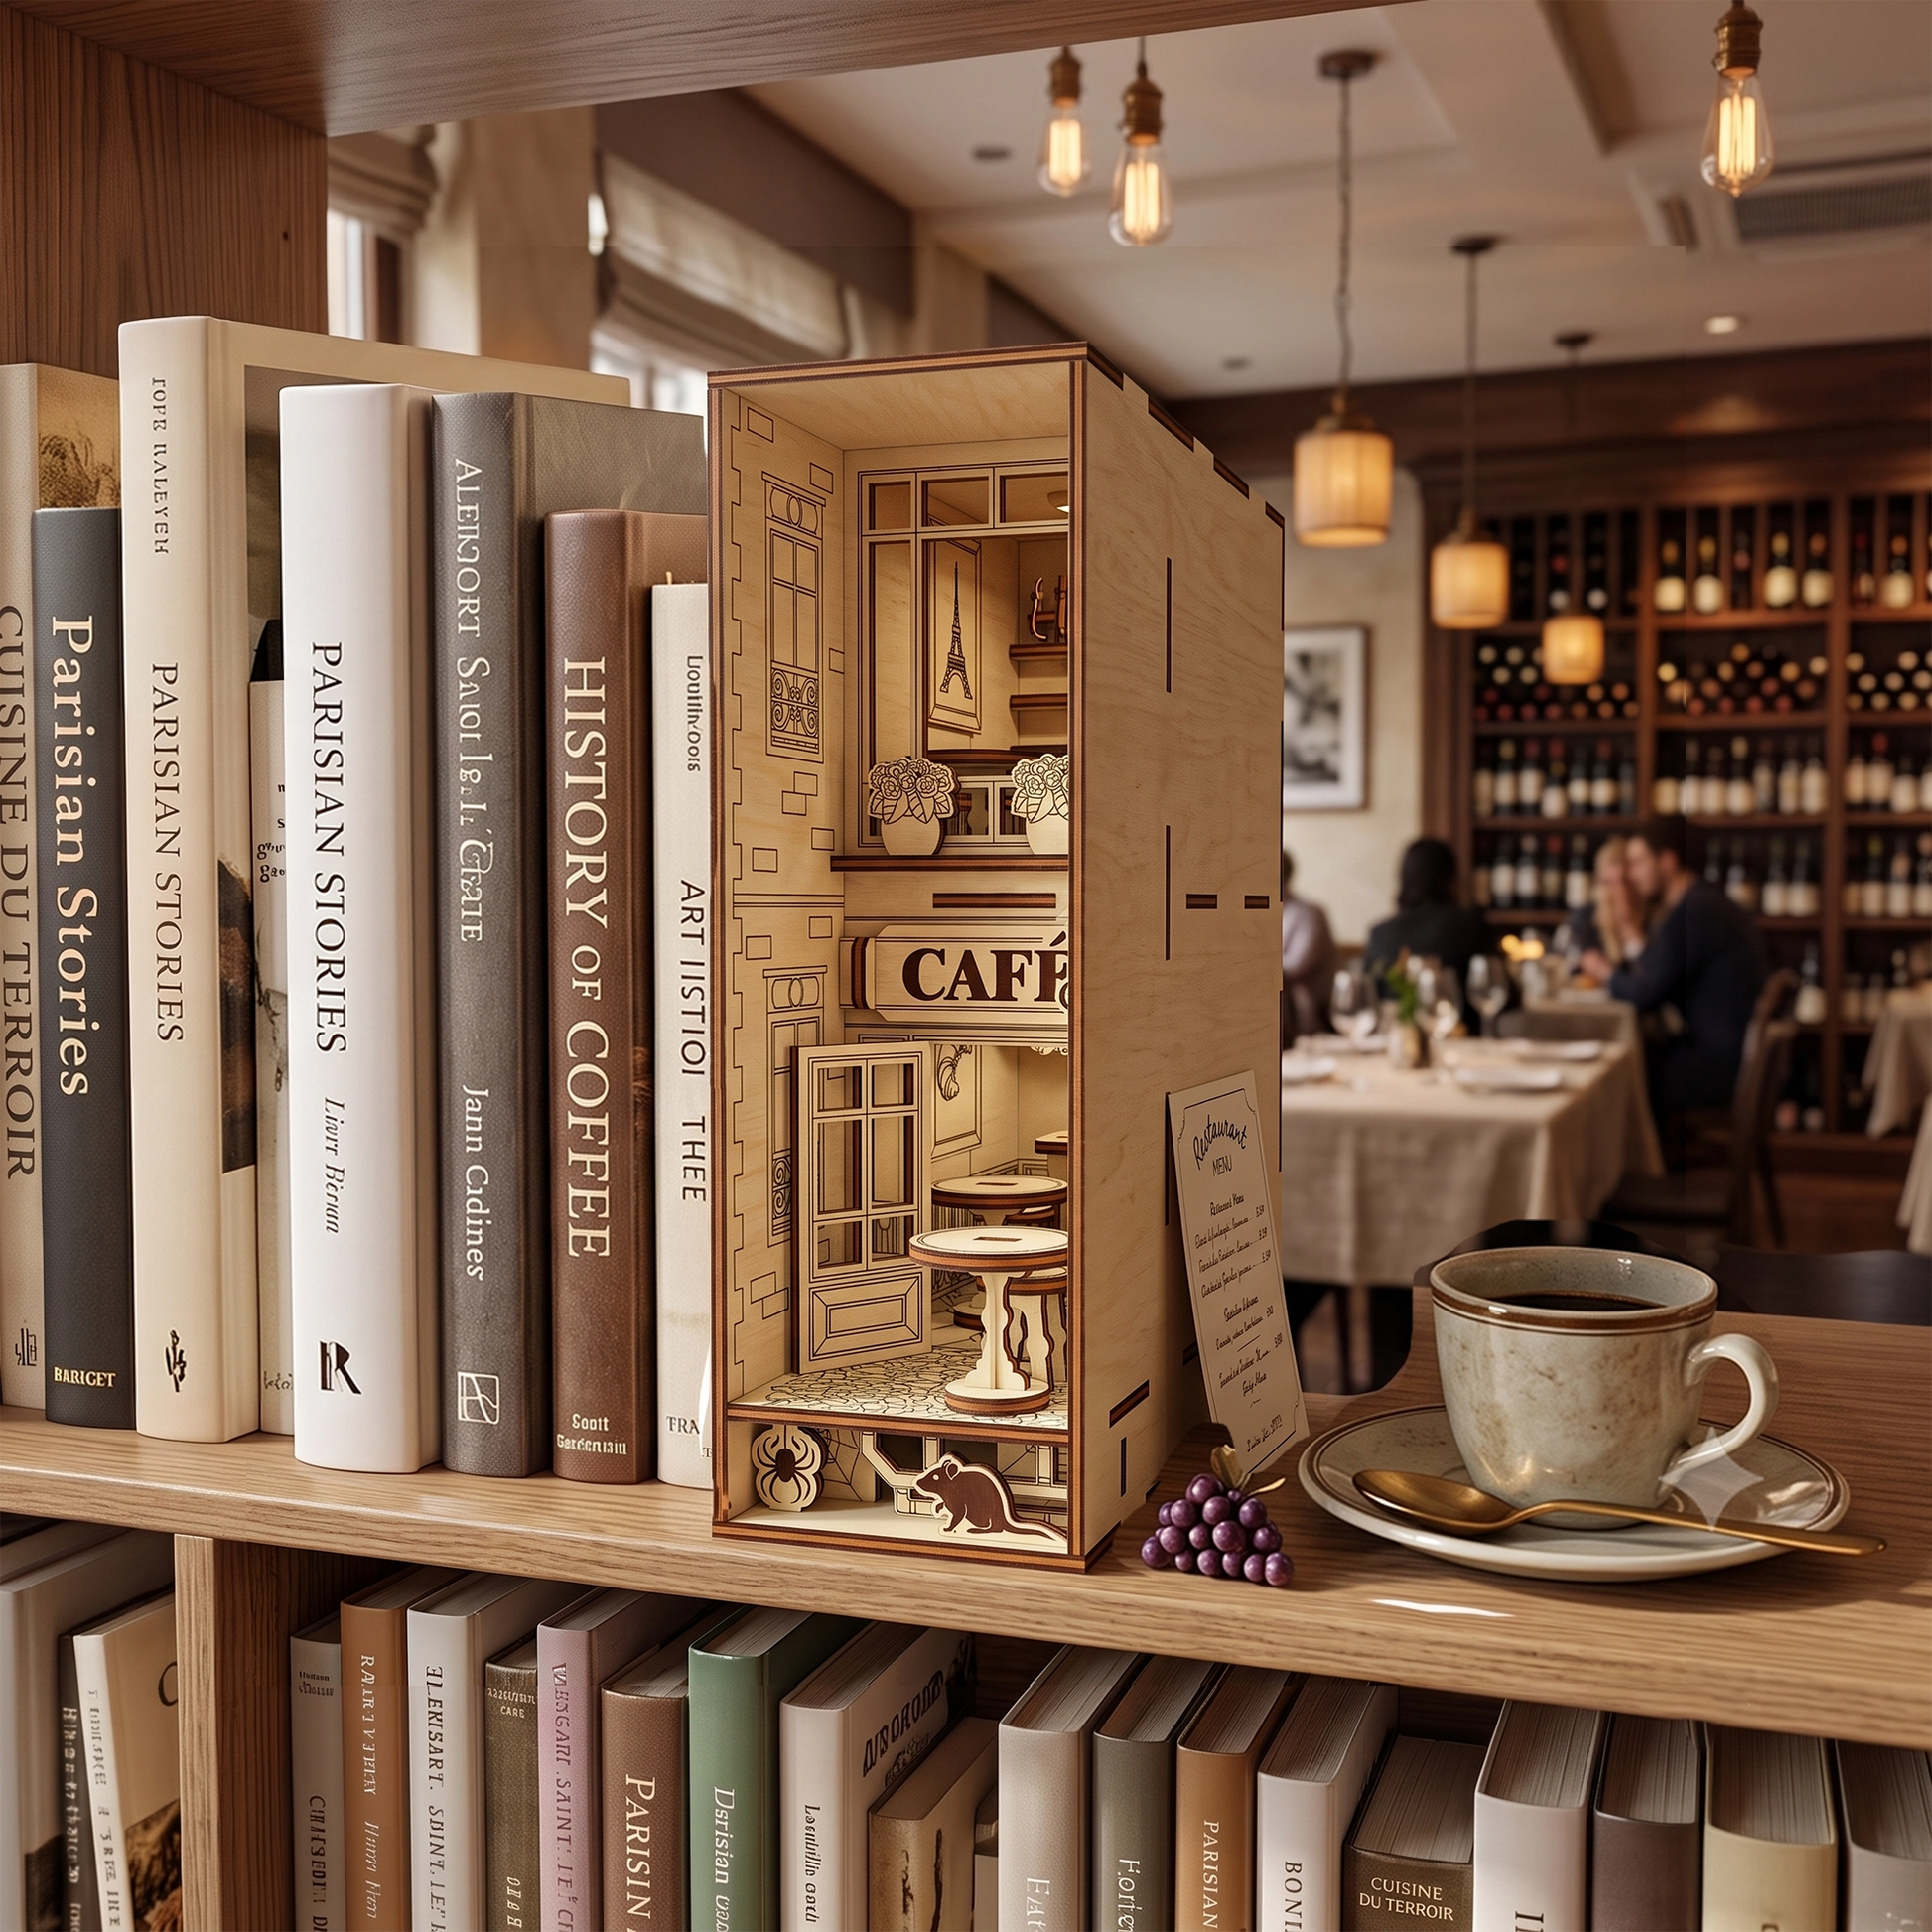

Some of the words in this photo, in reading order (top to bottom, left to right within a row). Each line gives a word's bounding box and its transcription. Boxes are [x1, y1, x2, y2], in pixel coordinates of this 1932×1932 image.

[0, 605, 28, 825] CUISINE
[53, 616, 97, 867] Parisian
[152, 662, 181, 858] PARISIAN
[312, 642, 345, 858] PARISIAN
[563, 657, 607, 929] HISTORY
[0, 844, 30, 922] DU
[155, 871, 184, 1041] STORIES
[315, 872, 347, 1052] STORIES
[681, 880, 706, 945] ART
[58, 887, 101, 1097] Stories
[572, 945, 602, 1002] OF
[2, 942, 36, 1179] TERROIR
[566, 1020, 610, 1259] COFFEE
[1192, 1114, 1248, 1171] Restaurant
[1212, 1155, 1233, 1176] MENU
[625, 1774, 656, 1919] PARISIN
[1202, 1820, 1220, 1929] PARISIAN
[1359, 1892, 1382, 1909] DU
[1385, 1897, 1454, 1921] TERROIR
[1370, 1877, 1443, 1901] CUISINE
